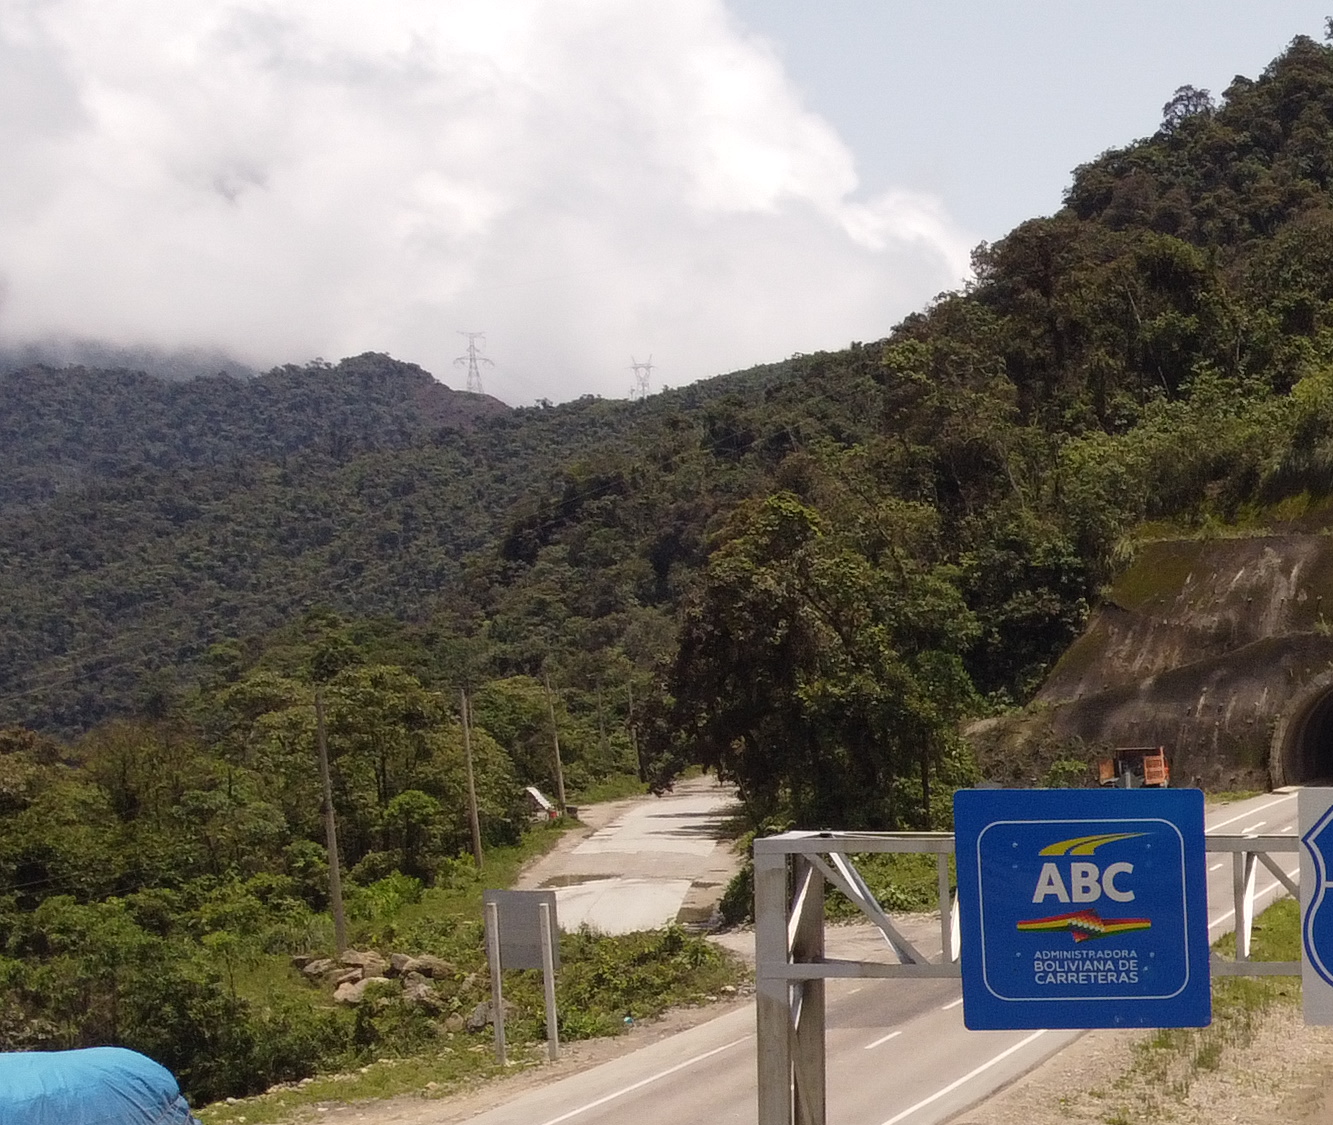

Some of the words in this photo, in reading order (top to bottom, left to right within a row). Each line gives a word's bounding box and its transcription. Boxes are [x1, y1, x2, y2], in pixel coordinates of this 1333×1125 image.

[1032, 862, 1135, 904] ABC
[1034, 949, 1138, 960] ADMINISTRADORA
[1033, 960, 1114, 972] BOLIVIANA
[1118, 960, 1138, 972] DE
[1034, 972, 1139, 984] CARRETERAS
